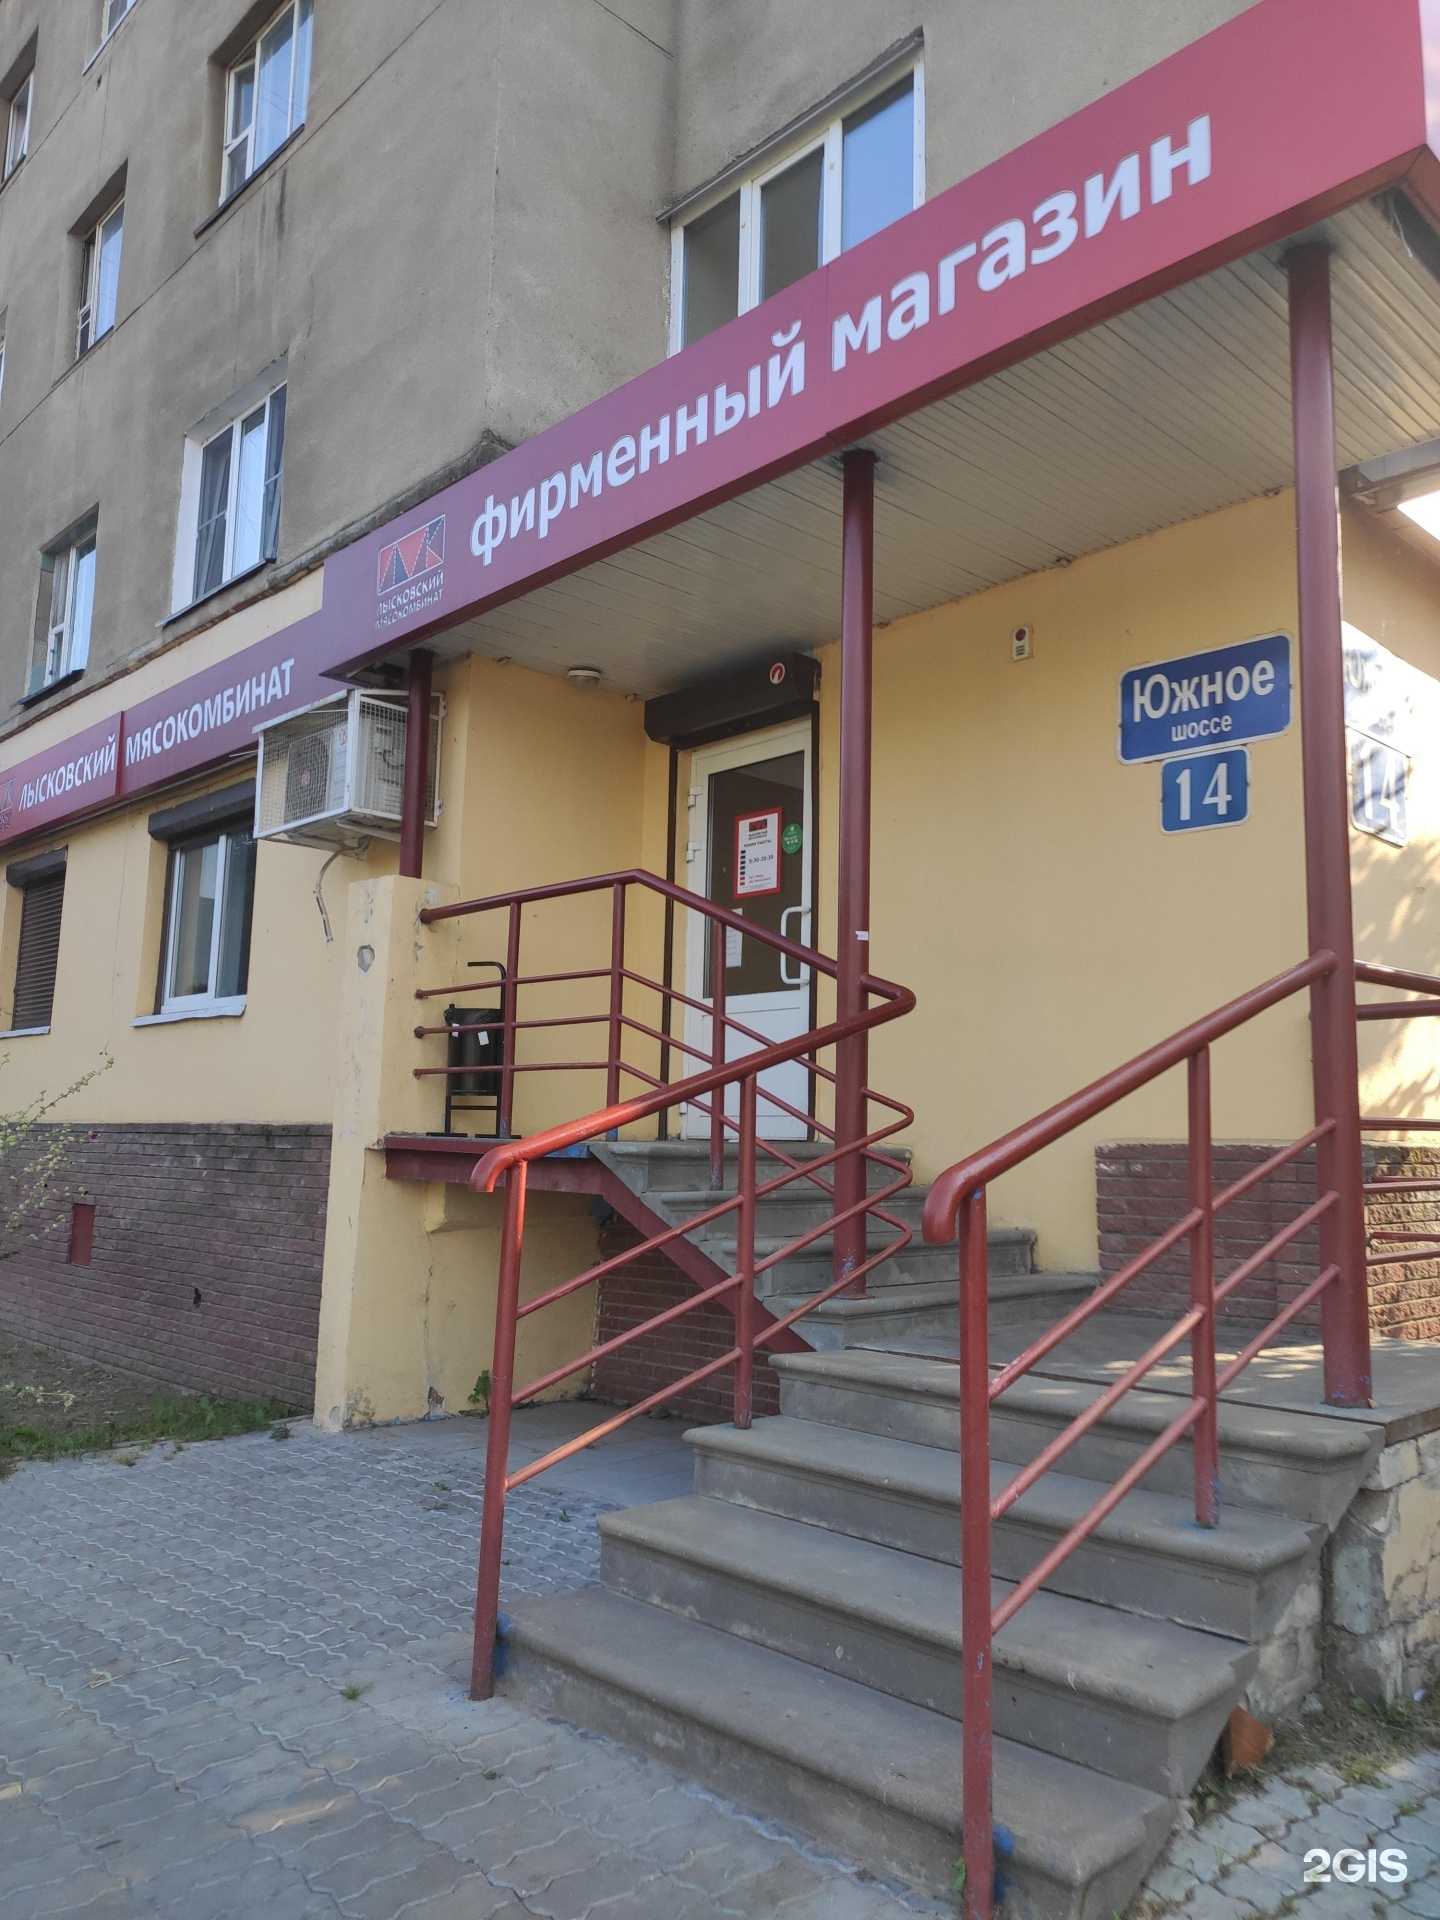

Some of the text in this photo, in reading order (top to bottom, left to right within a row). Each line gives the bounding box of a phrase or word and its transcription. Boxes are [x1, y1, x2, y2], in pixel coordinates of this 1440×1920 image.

[470, 113, 1212, 566] фирменный магазин
[1132, 659, 1275, 722] Южное
[18, 658, 295, 812] ЛЫСКОВСКИЙ МЯСОКОМБИНАТ
[1171, 714, 1232, 742] шоссе
[1176, 762, 1232, 821] 14
